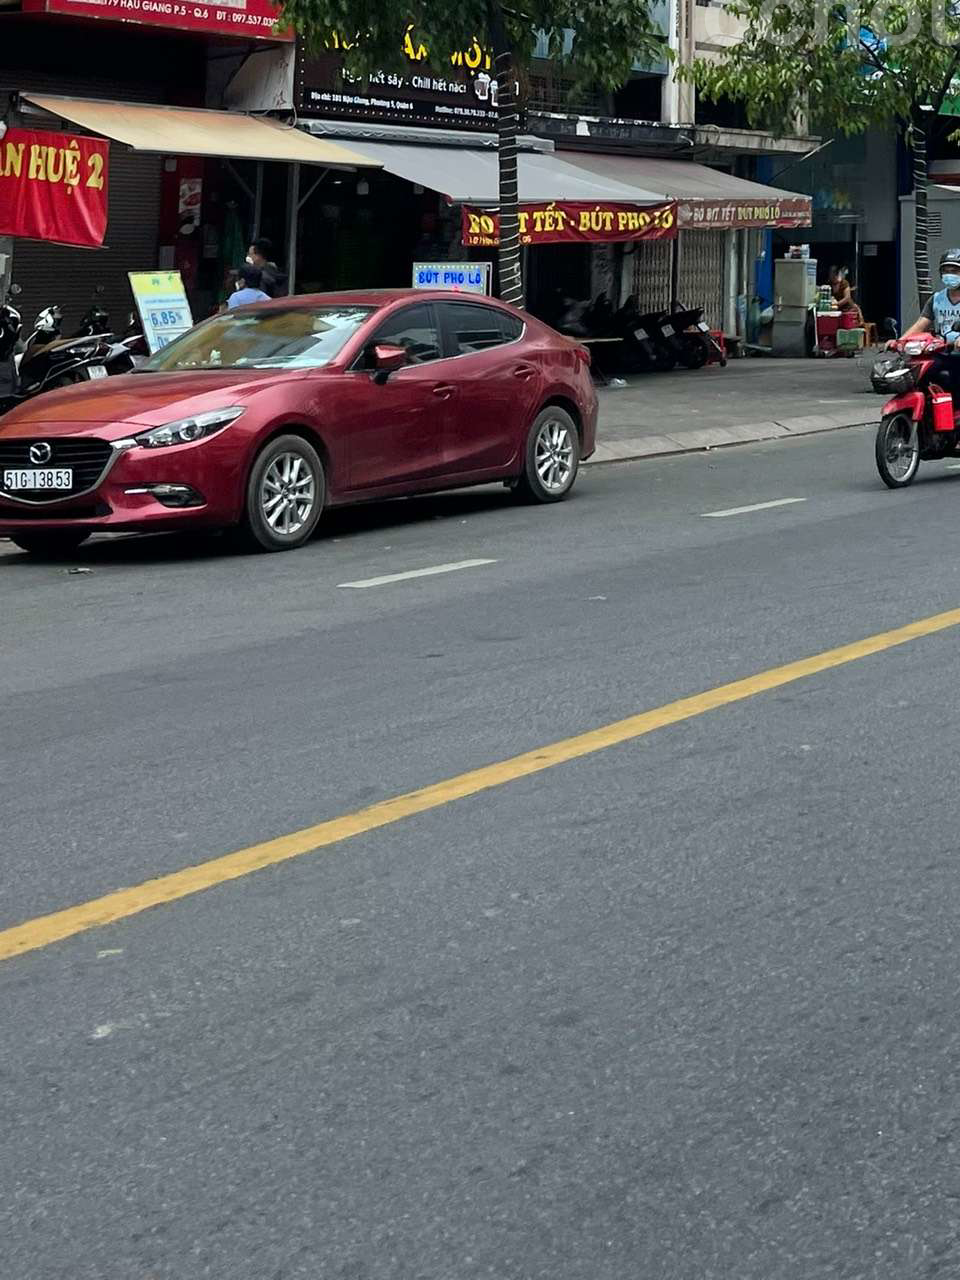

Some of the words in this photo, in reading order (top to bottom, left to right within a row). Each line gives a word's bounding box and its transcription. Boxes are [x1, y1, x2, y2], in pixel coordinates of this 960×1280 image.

[142, 1, 172, 14] GIANG
[412, 76, 431, 89] Chill
[0, 143, 25, 178] N
[28, 139, 80, 195] HUỆ
[86, 153, 104, 191] 2
[533, 203, 566, 231] TẾT
[579, 206, 614, 231] BÚT
